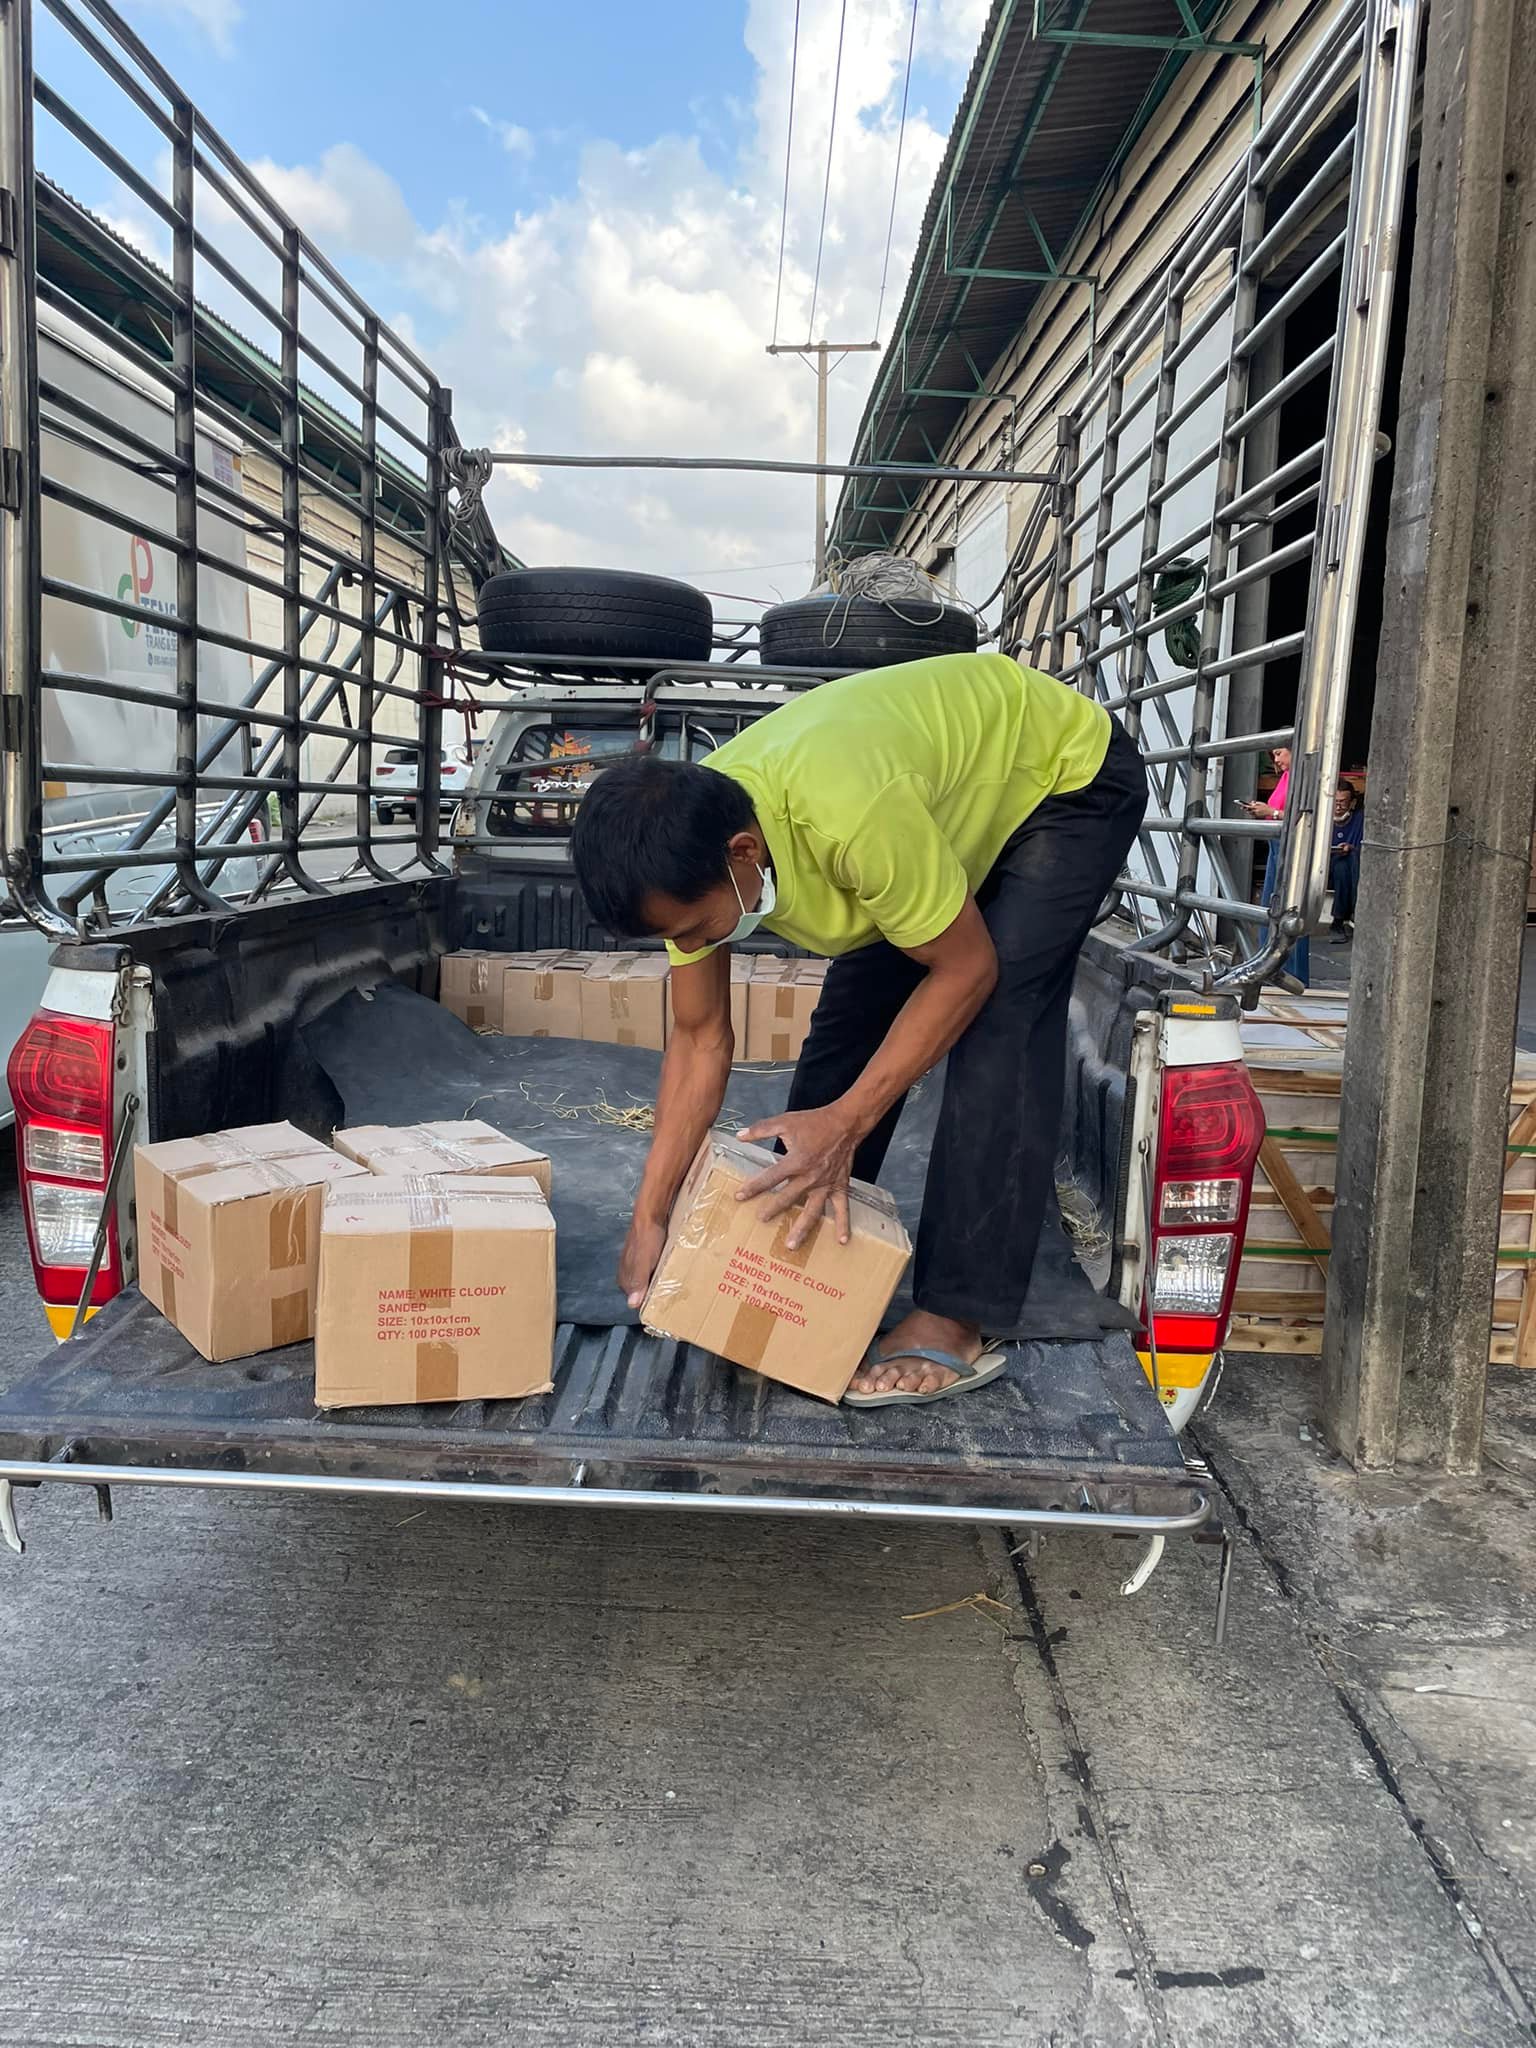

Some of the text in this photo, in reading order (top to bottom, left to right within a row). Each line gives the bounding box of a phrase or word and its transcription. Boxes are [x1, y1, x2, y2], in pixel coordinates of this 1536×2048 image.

[729, 1259, 772, 1284] SANDED
[735, 1246, 846, 1301] NAME: WHITE CLOUDY
[379, 1286, 507, 1300] NAME: WHITE CLOUDY
[723, 1270, 804, 1312] SIZE: 10x10x1cm
[378, 1303, 427, 1313] SANDED
[718, 1282, 808, 1328] QTY: 100 PCS/BOX
[377, 1315, 471, 1327] SIZE: 10x10x1cm
[377, 1326, 481, 1340] QTY: 100 PCS/BOX
